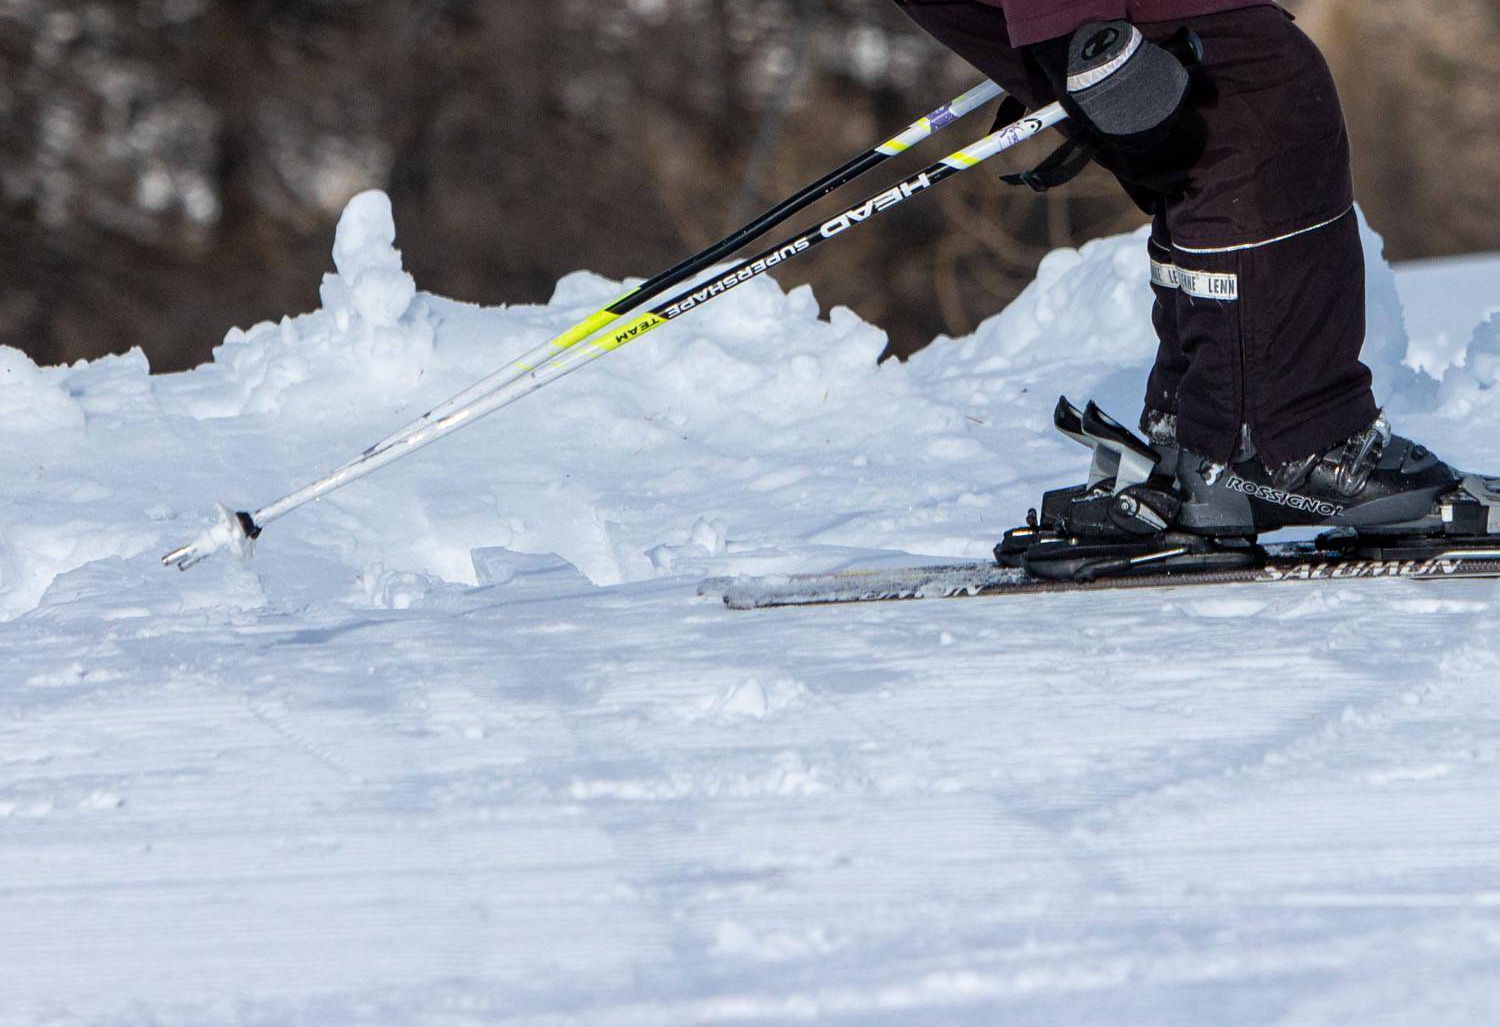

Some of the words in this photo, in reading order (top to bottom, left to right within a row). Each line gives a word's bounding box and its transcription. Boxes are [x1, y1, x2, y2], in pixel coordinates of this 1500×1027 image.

[819, 172, 931, 238] HEAD
[667, 236, 811, 320] SUPERSHAPE
[615, 318, 661, 343] TEAM
[1226, 475, 1345, 517] ROSSIGNOL
